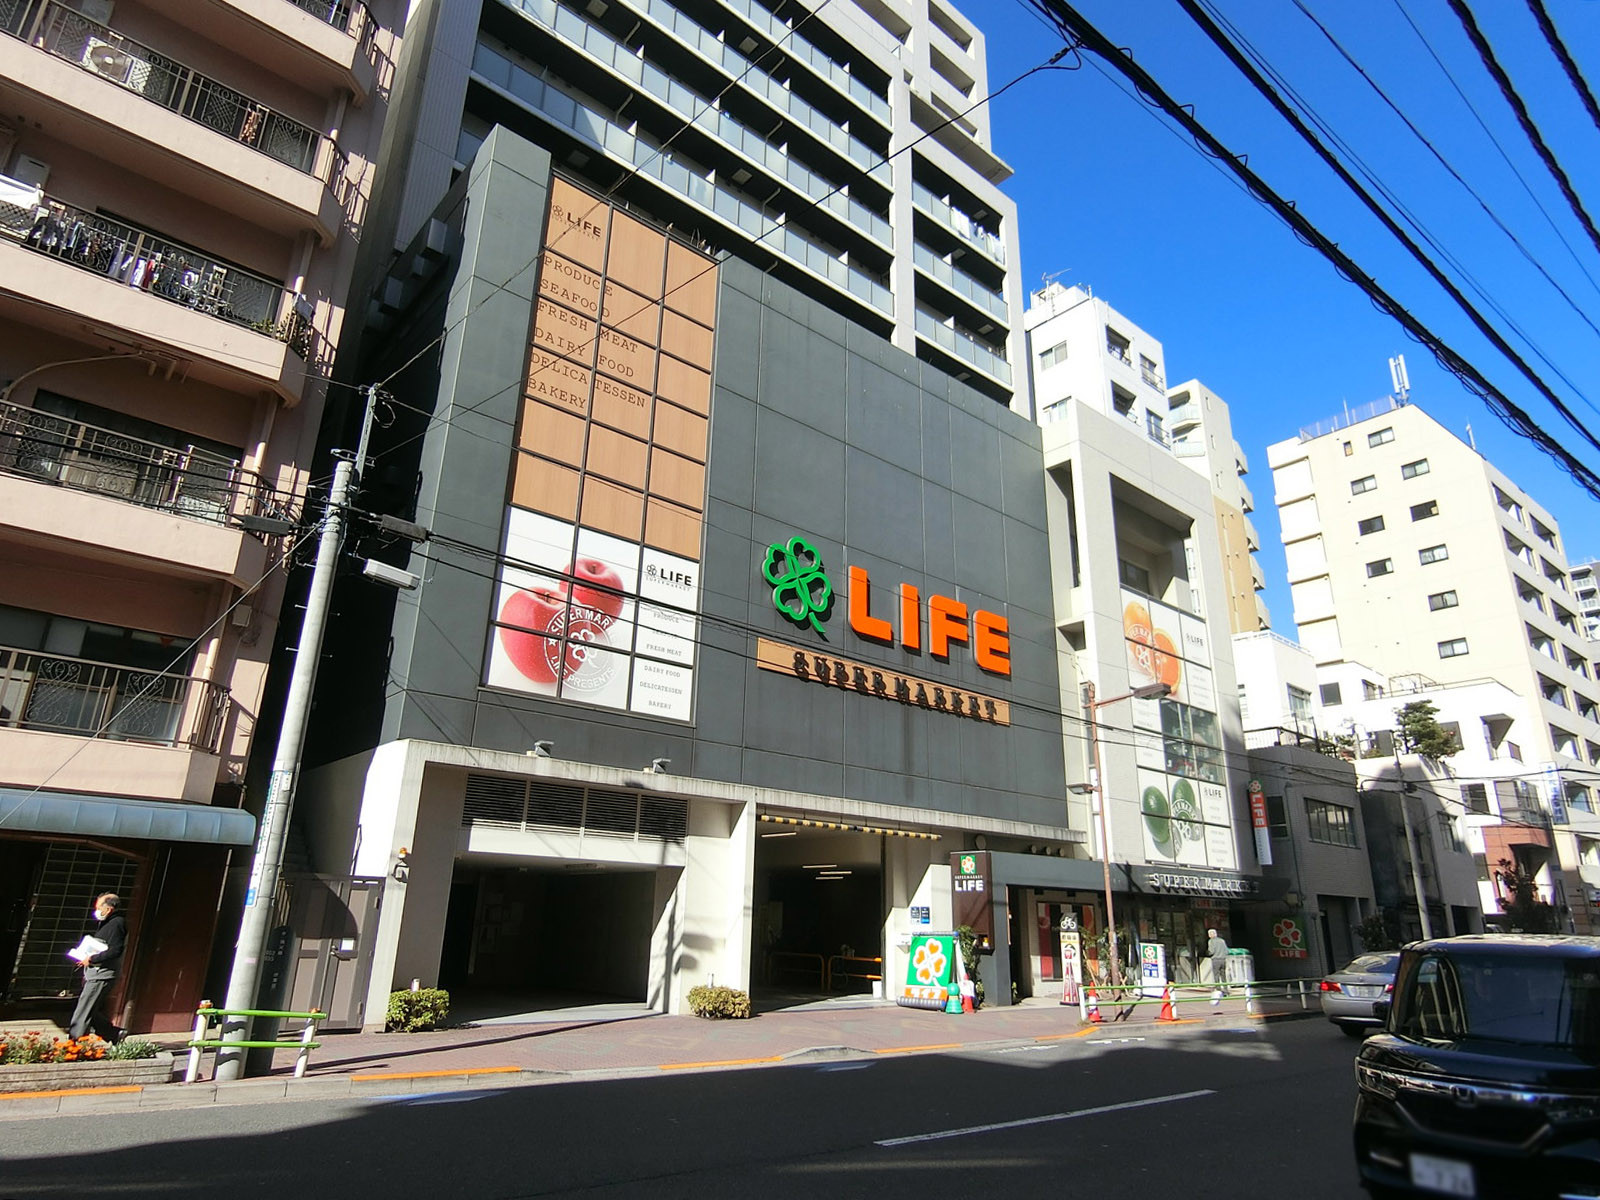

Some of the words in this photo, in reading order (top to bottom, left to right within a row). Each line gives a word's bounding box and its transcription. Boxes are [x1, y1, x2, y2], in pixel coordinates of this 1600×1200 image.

[567, 212, 601, 238] LIFE
[543, 255, 614, 297] PRODUCE
[540, 278, 611, 318] SEAFOOD
[537, 301, 589, 331] FRESH
[600, 329, 639, 354] MEAT
[534, 328, 586, 357] DAIRY
[599, 354, 635, 378] FOOD
[527, 378, 587, 409] BAKERY
[531, 352, 646, 408] DELICATESSEN
[661, 568, 692, 587] LIFE
[848, 565, 1010, 676] LIFE
[666, 647, 682, 657] MEAT
[1190, 635, 1204, 647] LIFE
[644, 665, 664, 675] DAIRY
[665, 669, 681, 678] FOOD
[1208, 788, 1222, 799] LIFE
[1253, 794, 1264, 826] LIFE
[955, 879, 984, 892] LIFE
[1280, 950, 1301, 958] LIFE
